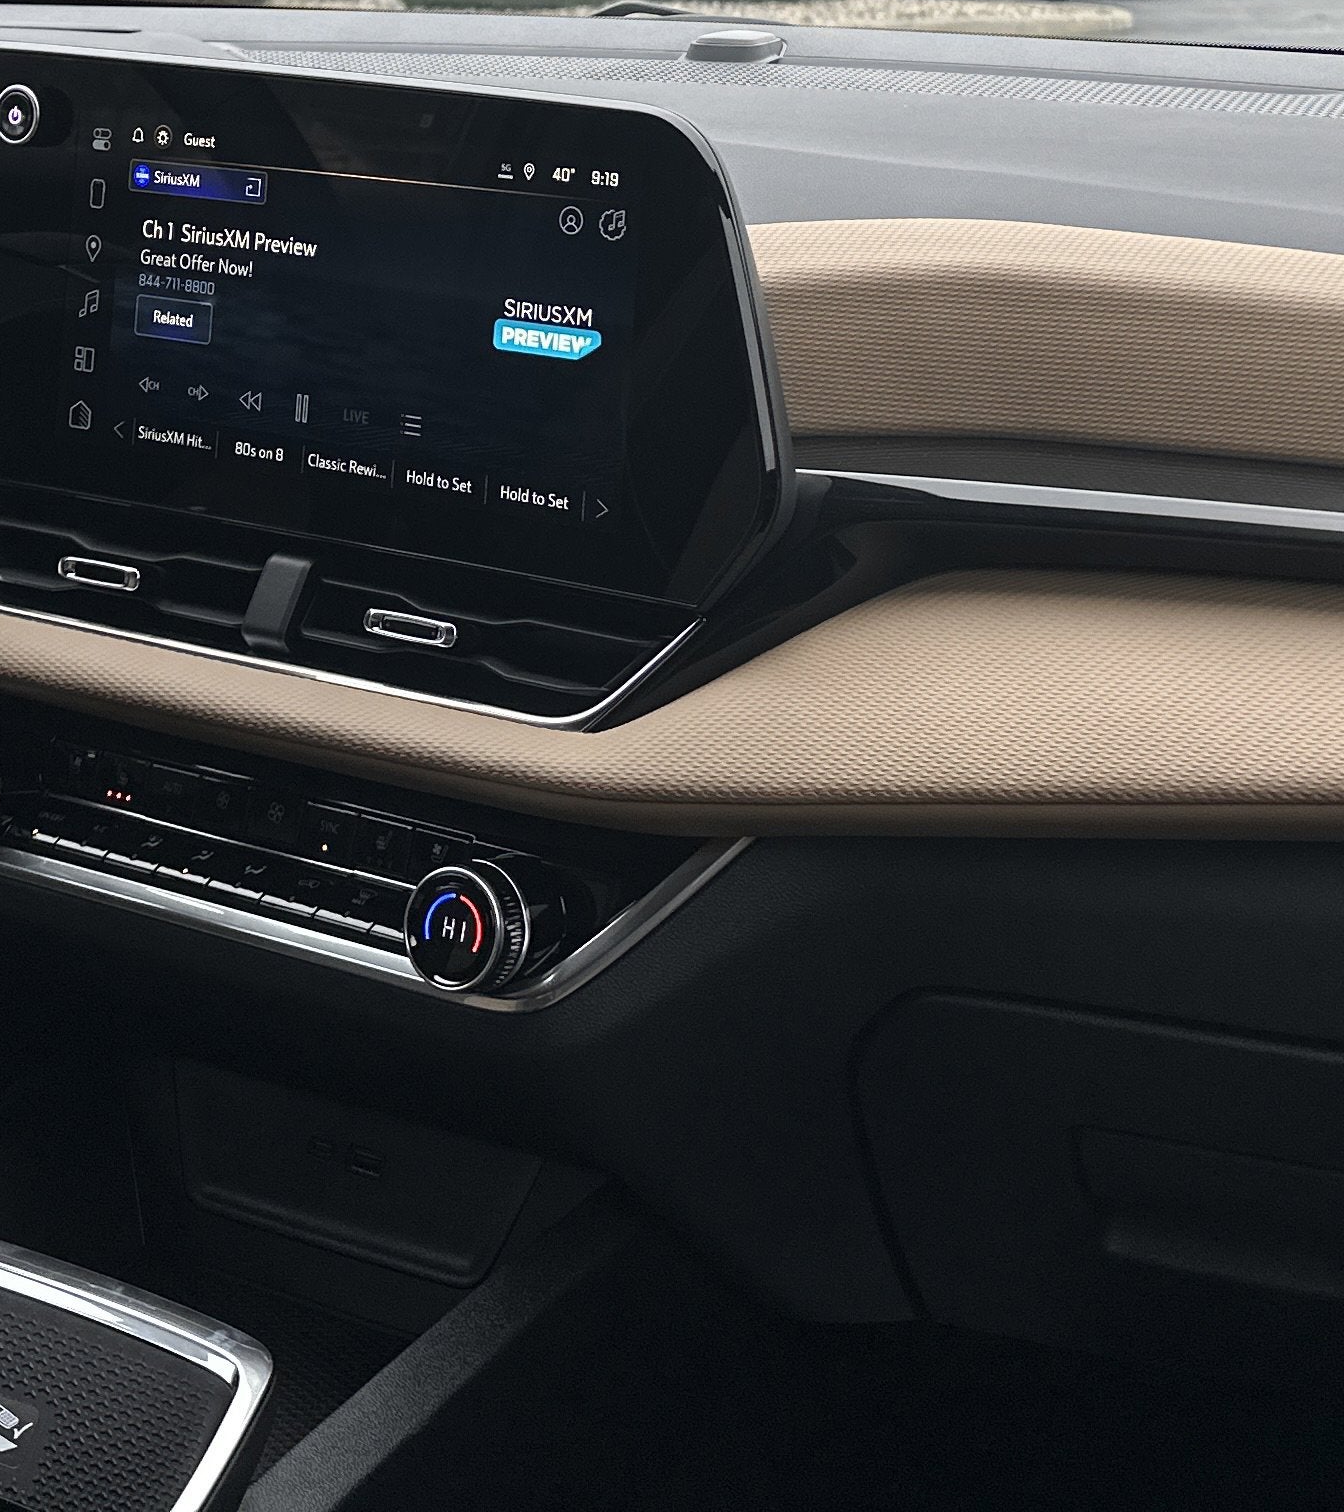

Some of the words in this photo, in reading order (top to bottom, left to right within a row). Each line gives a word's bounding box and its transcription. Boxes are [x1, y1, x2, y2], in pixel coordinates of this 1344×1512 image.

[183, 132, 216, 149] Guest
[153, 170, 200, 188] SiriusXM
[591, 170, 619, 187] 9:19
[142, 219, 163, 239] Ch
[167, 221, 174, 240] 1
[181, 223, 250, 250] SiriusXM
[254, 232, 317, 258] Preview
[140, 248, 177, 268] Great
[179, 253, 215, 273] Offer
[218, 257, 254, 278] Now!
[138, 273, 215, 296] 844-711-8800
[153, 309, 194, 328] Related
[503, 298, 593, 327] SIRIUSXM
[501, 326, 593, 354] PREVIEW
[343, 407, 370, 425] LIVE
[137, 425, 185, 446] SiriusXM
[234, 441, 256, 458] 80s
[258, 448, 273, 461] on
[275, 448, 284, 462] 8
[307, 453, 347, 473] Classic
[406, 469, 434, 487] Hold
[437, 475, 449, 490] to
[452, 477, 472, 494] Set
[500, 485, 529, 504] Hold
[532, 491, 545, 506] to
[548, 493, 569, 510] Set
[319, 819, 341, 836] SYNC
[442, 915, 467, 943] HI
